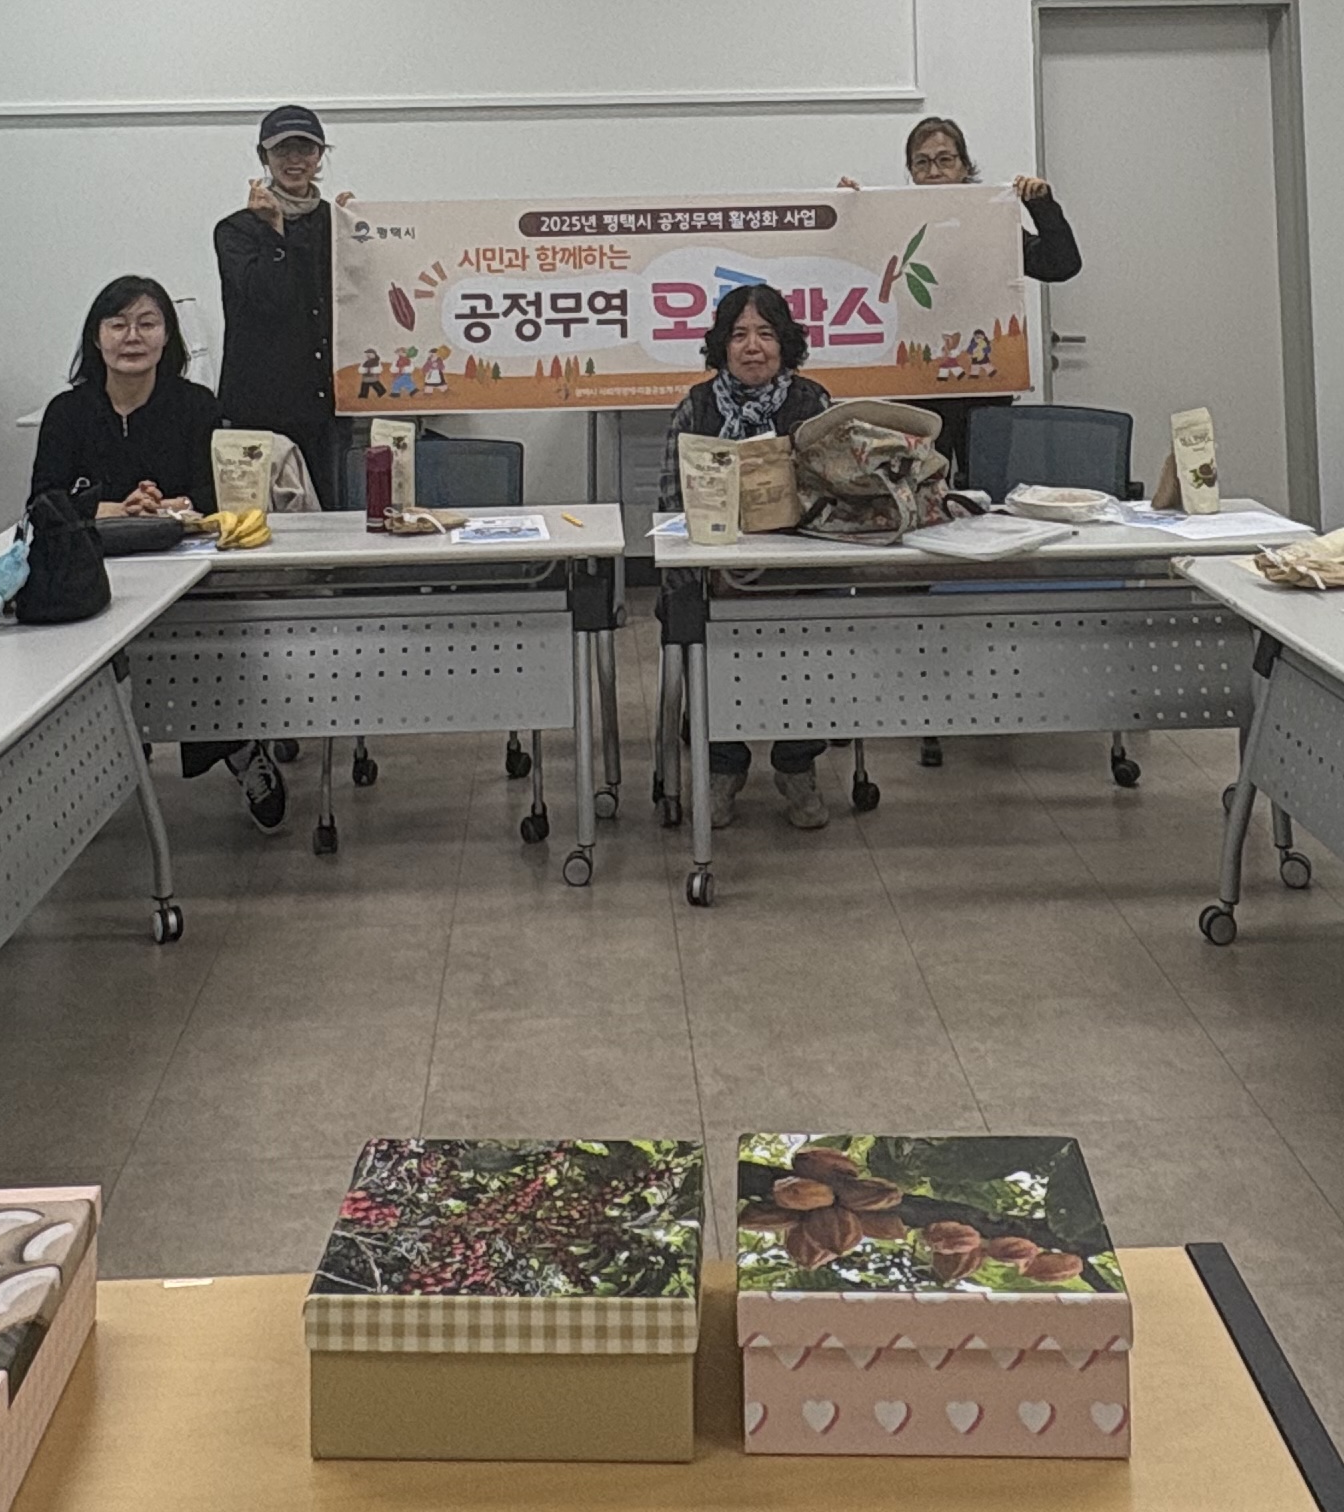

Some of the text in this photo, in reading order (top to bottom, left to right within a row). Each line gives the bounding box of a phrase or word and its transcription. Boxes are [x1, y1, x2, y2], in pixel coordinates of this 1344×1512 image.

[376, 226, 416, 240] 평택시
[540, 208, 816, 233] 2025년 평택시 공정무역 활성화 사업
[457, 244, 632, 274] 시민과 함께하는
[454, 272, 885, 348] 공정무역 오박스
